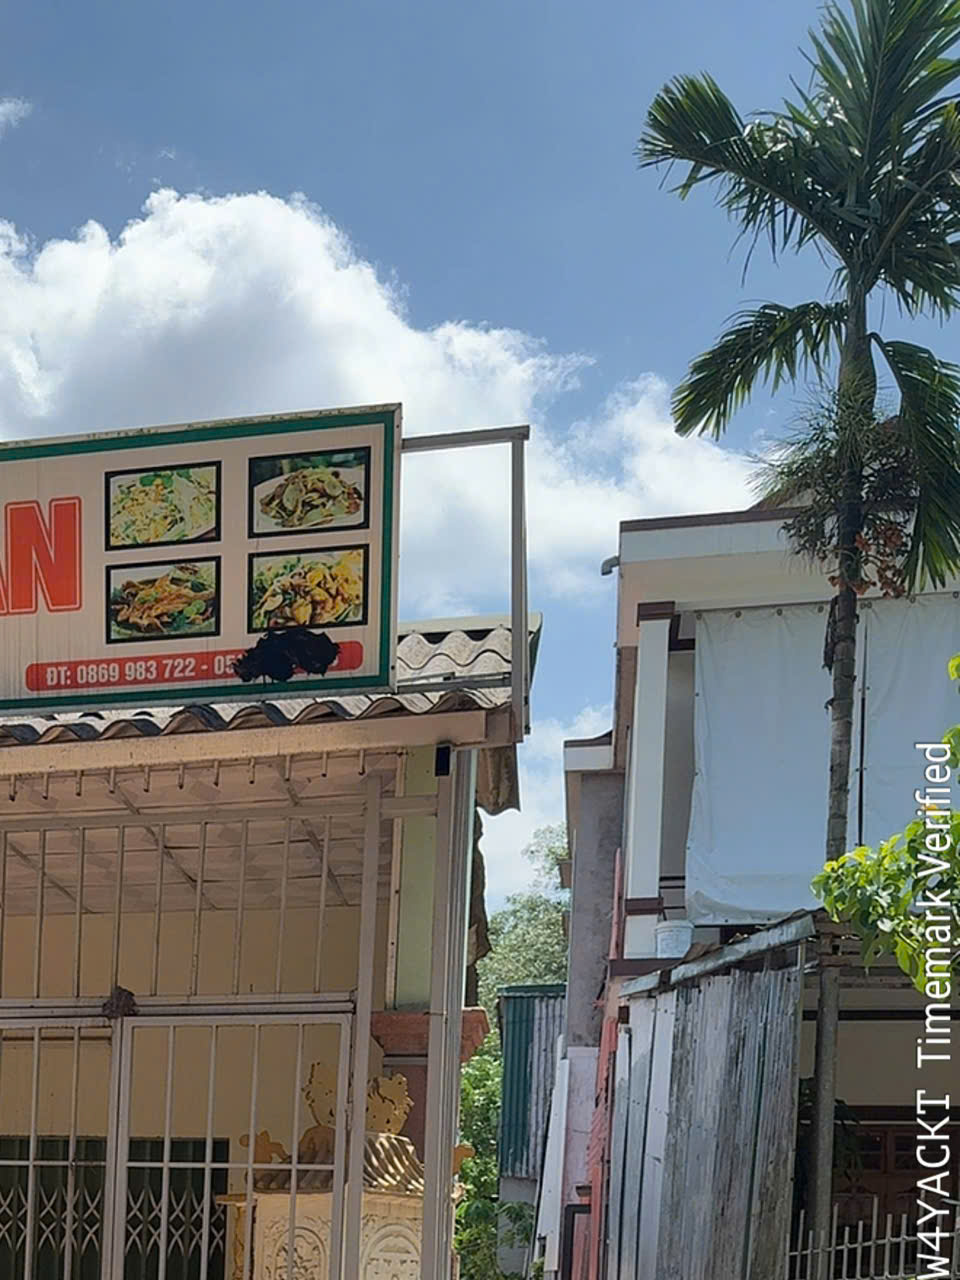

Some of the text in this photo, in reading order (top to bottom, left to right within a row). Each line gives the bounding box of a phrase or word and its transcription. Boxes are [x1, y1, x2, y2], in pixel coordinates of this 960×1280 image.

[45, 664, 72, 686] ĐT:
[76, 660, 120, 685] 0869
[124, 657, 158, 681] 983
[162, 654, 196, 678] 722
